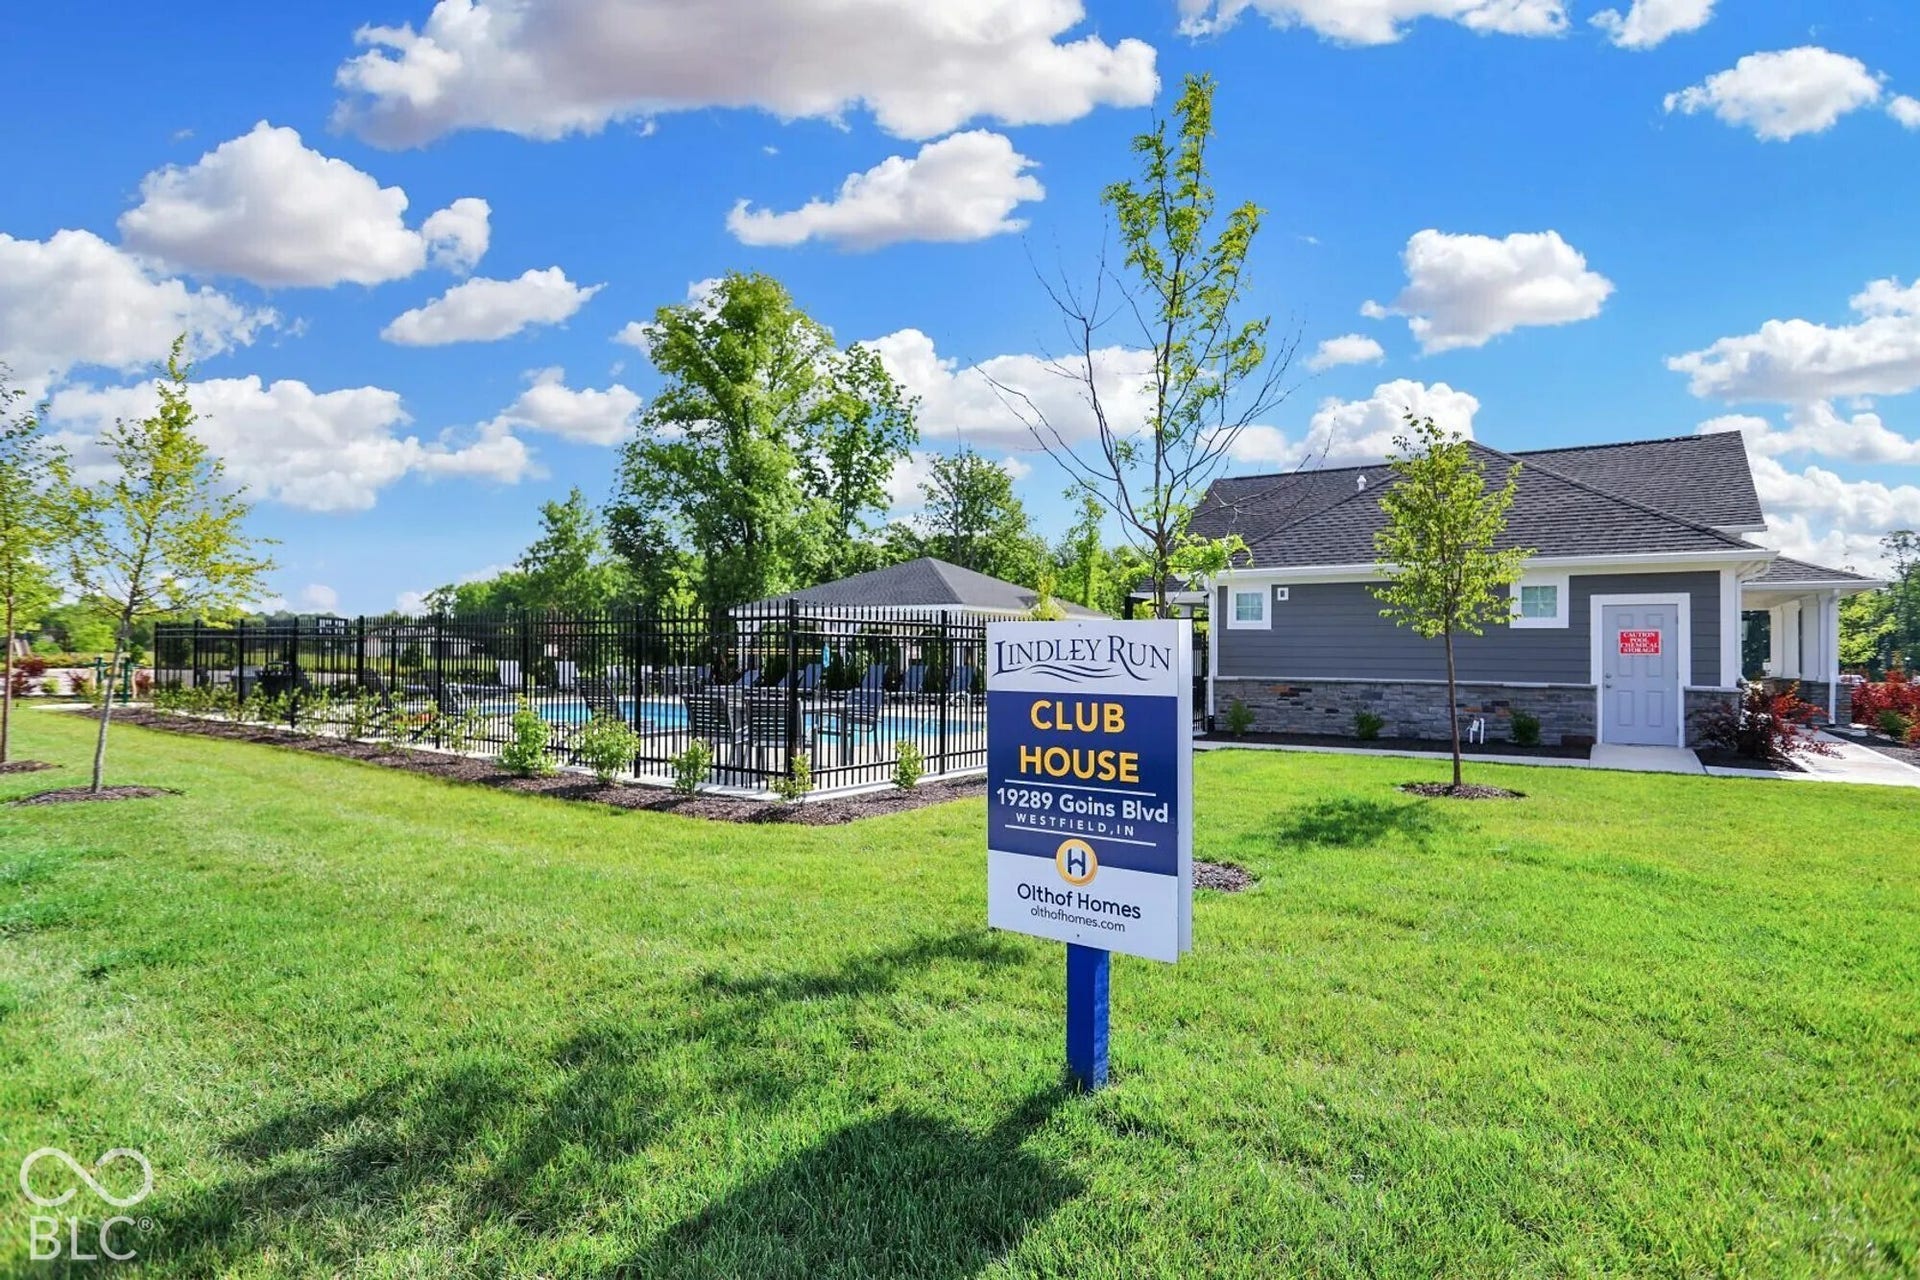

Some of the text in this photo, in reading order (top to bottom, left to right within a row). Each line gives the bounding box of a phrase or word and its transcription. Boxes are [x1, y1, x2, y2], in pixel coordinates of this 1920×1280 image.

[992, 635, 1171, 681] LINDLEY RUN
[1030, 699, 1126, 733] CLUB
[1020, 745, 1140, 783] HOUSE
[997, 787, 1169, 823] 19289 Goins Blvd
[1017, 883, 1141, 919] Olthof Homes
[1030, 905, 1126, 932] olthofhomes.com
